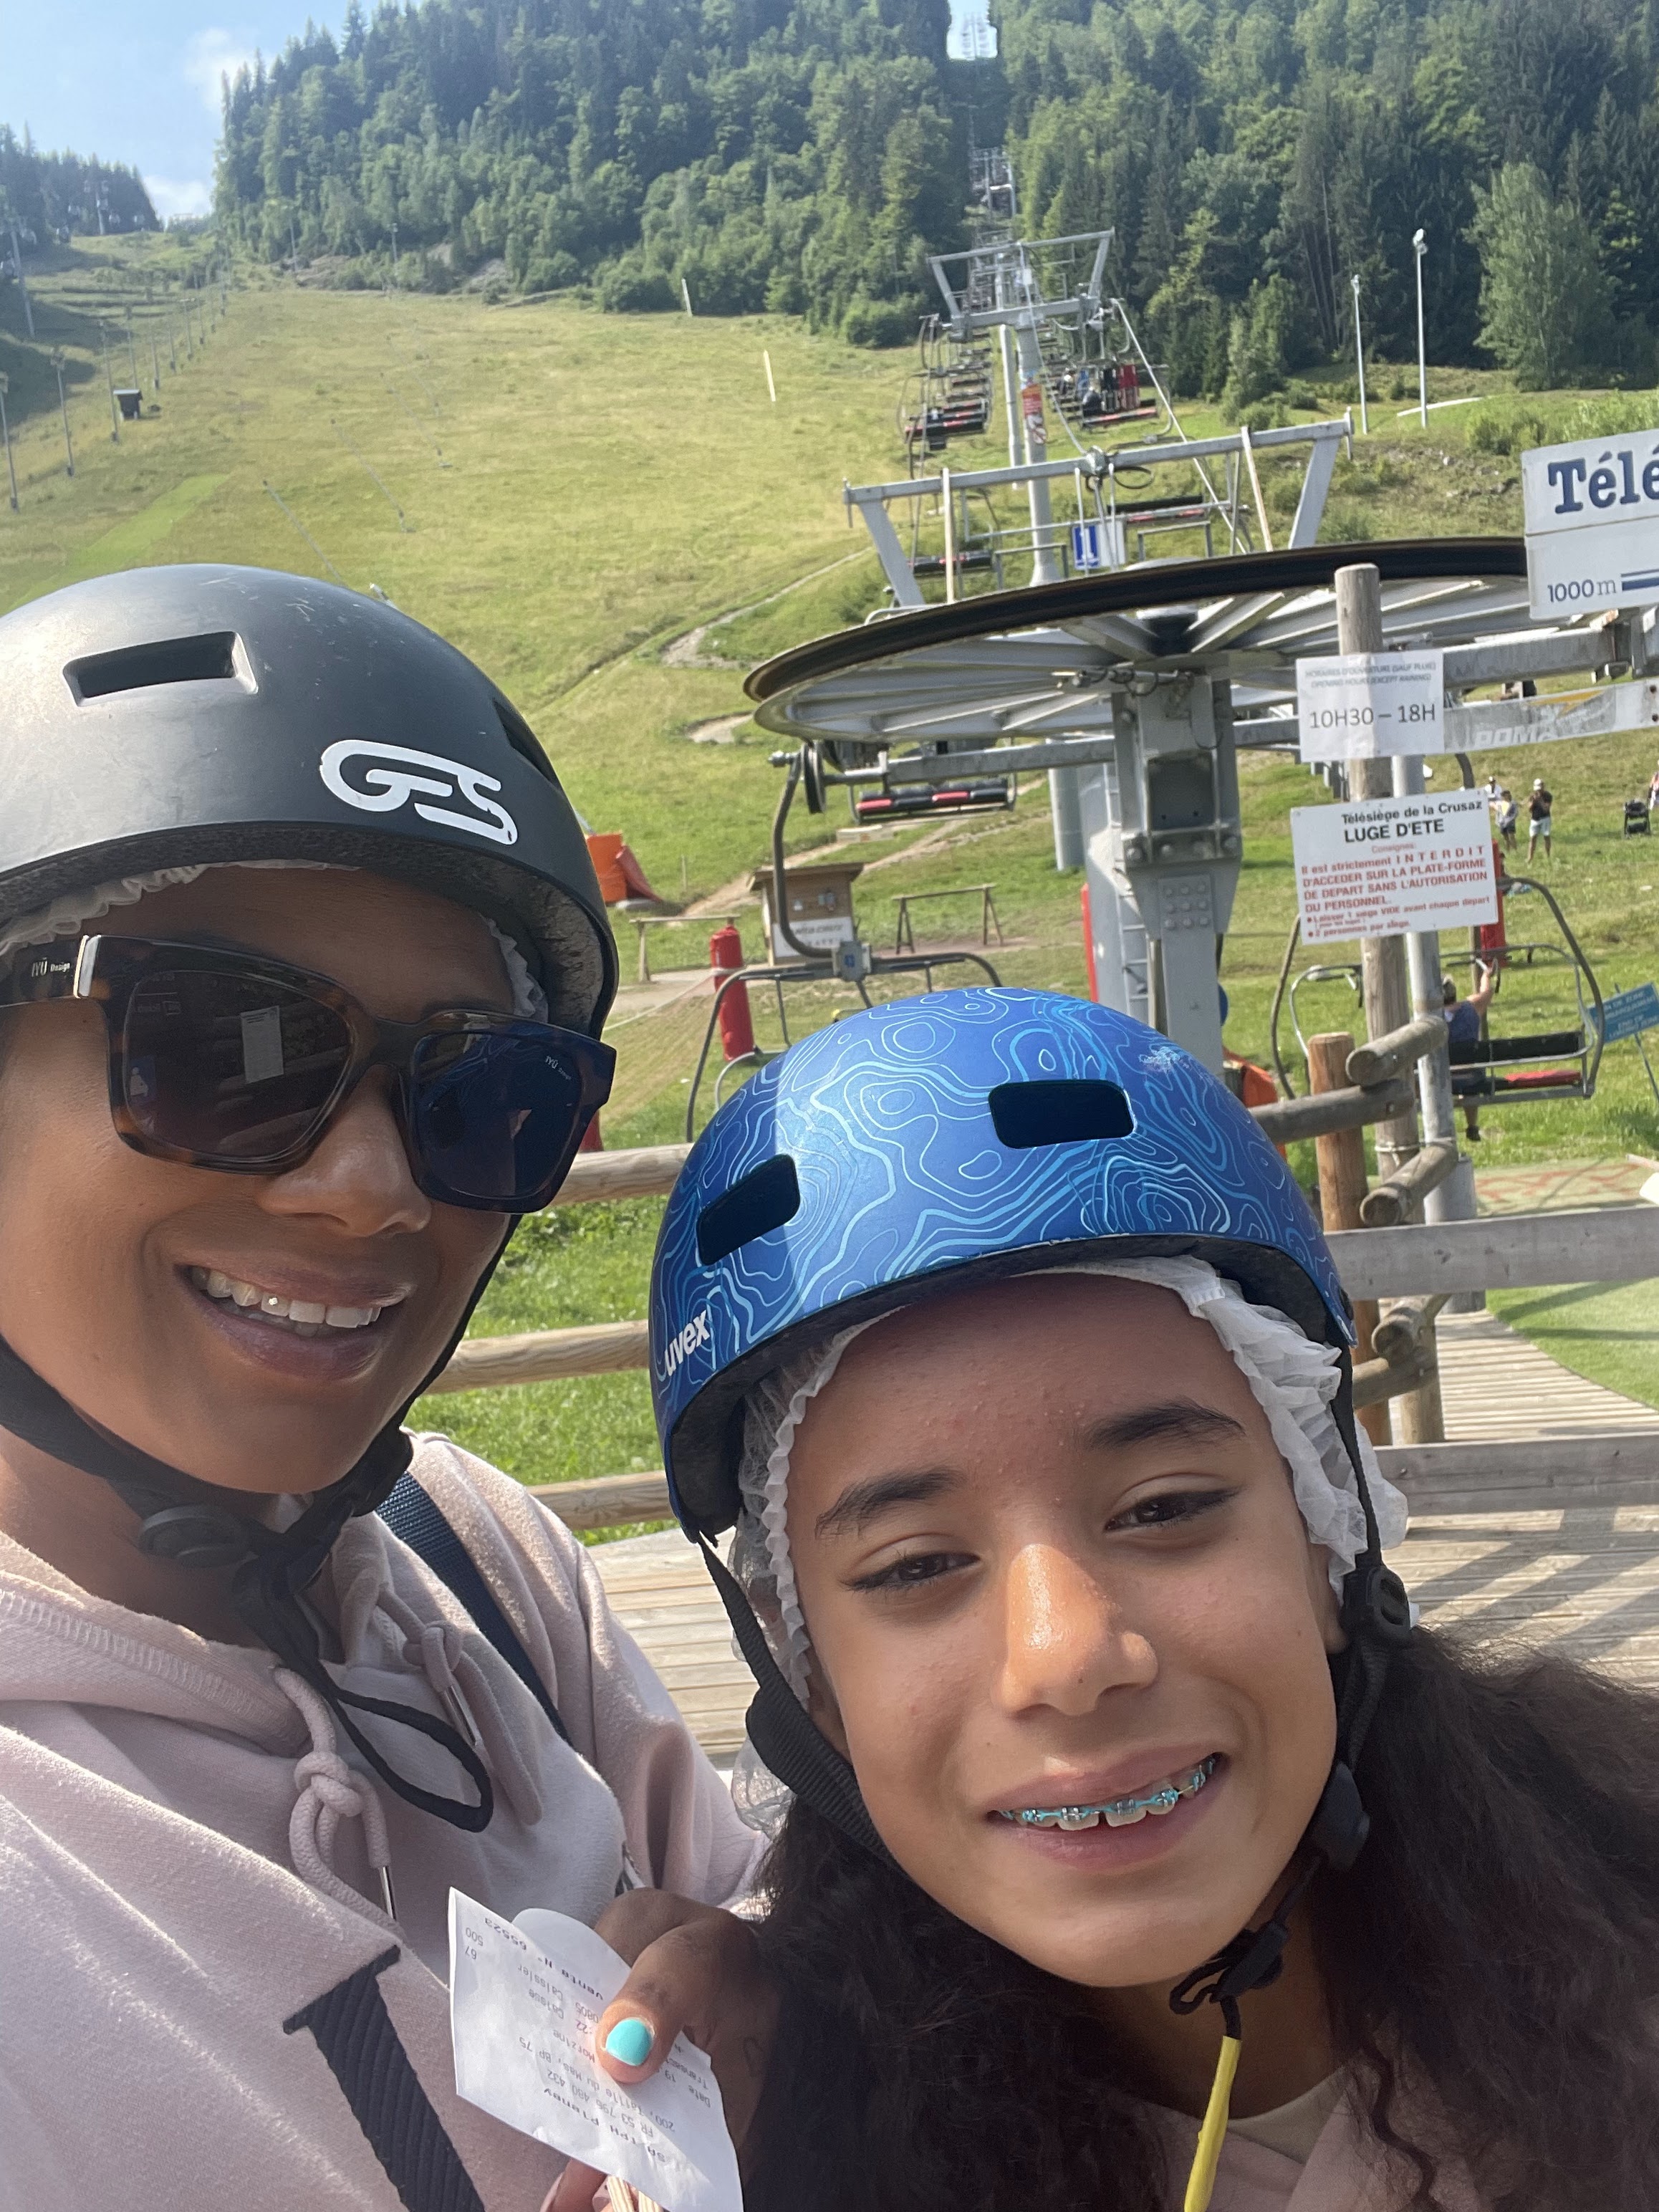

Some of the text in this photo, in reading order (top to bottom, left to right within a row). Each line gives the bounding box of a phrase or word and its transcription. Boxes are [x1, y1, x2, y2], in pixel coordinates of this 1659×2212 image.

[1309, 707, 1374, 728] 10H30
[1398, 703, 1436, 723] 18H
[1342, 801, 1482, 824] Télésiège de la Crusaz
[1345, 819, 1444, 842] LUGE D'ETE
[1303, 858, 1486, 888] D'ACCEDER SUR LA PLATE-FORME
[1312, 864, 1327, 873] est
[1332, 857, 1391, 872] strictement
[1304, 872, 1487, 900] DE DEPART SANS L'AUTORISATION
[1305, 903, 1321, 913] DU
[665, 1309, 710, 1376] uvex
[465, 1927, 484, 1947] 500
[465, 1946, 477, 1961] 67
[517, 1964, 564, 2003] Caissier
[528, 1989, 564, 2020] Caisse
[519, 2037, 533, 2052] 75
